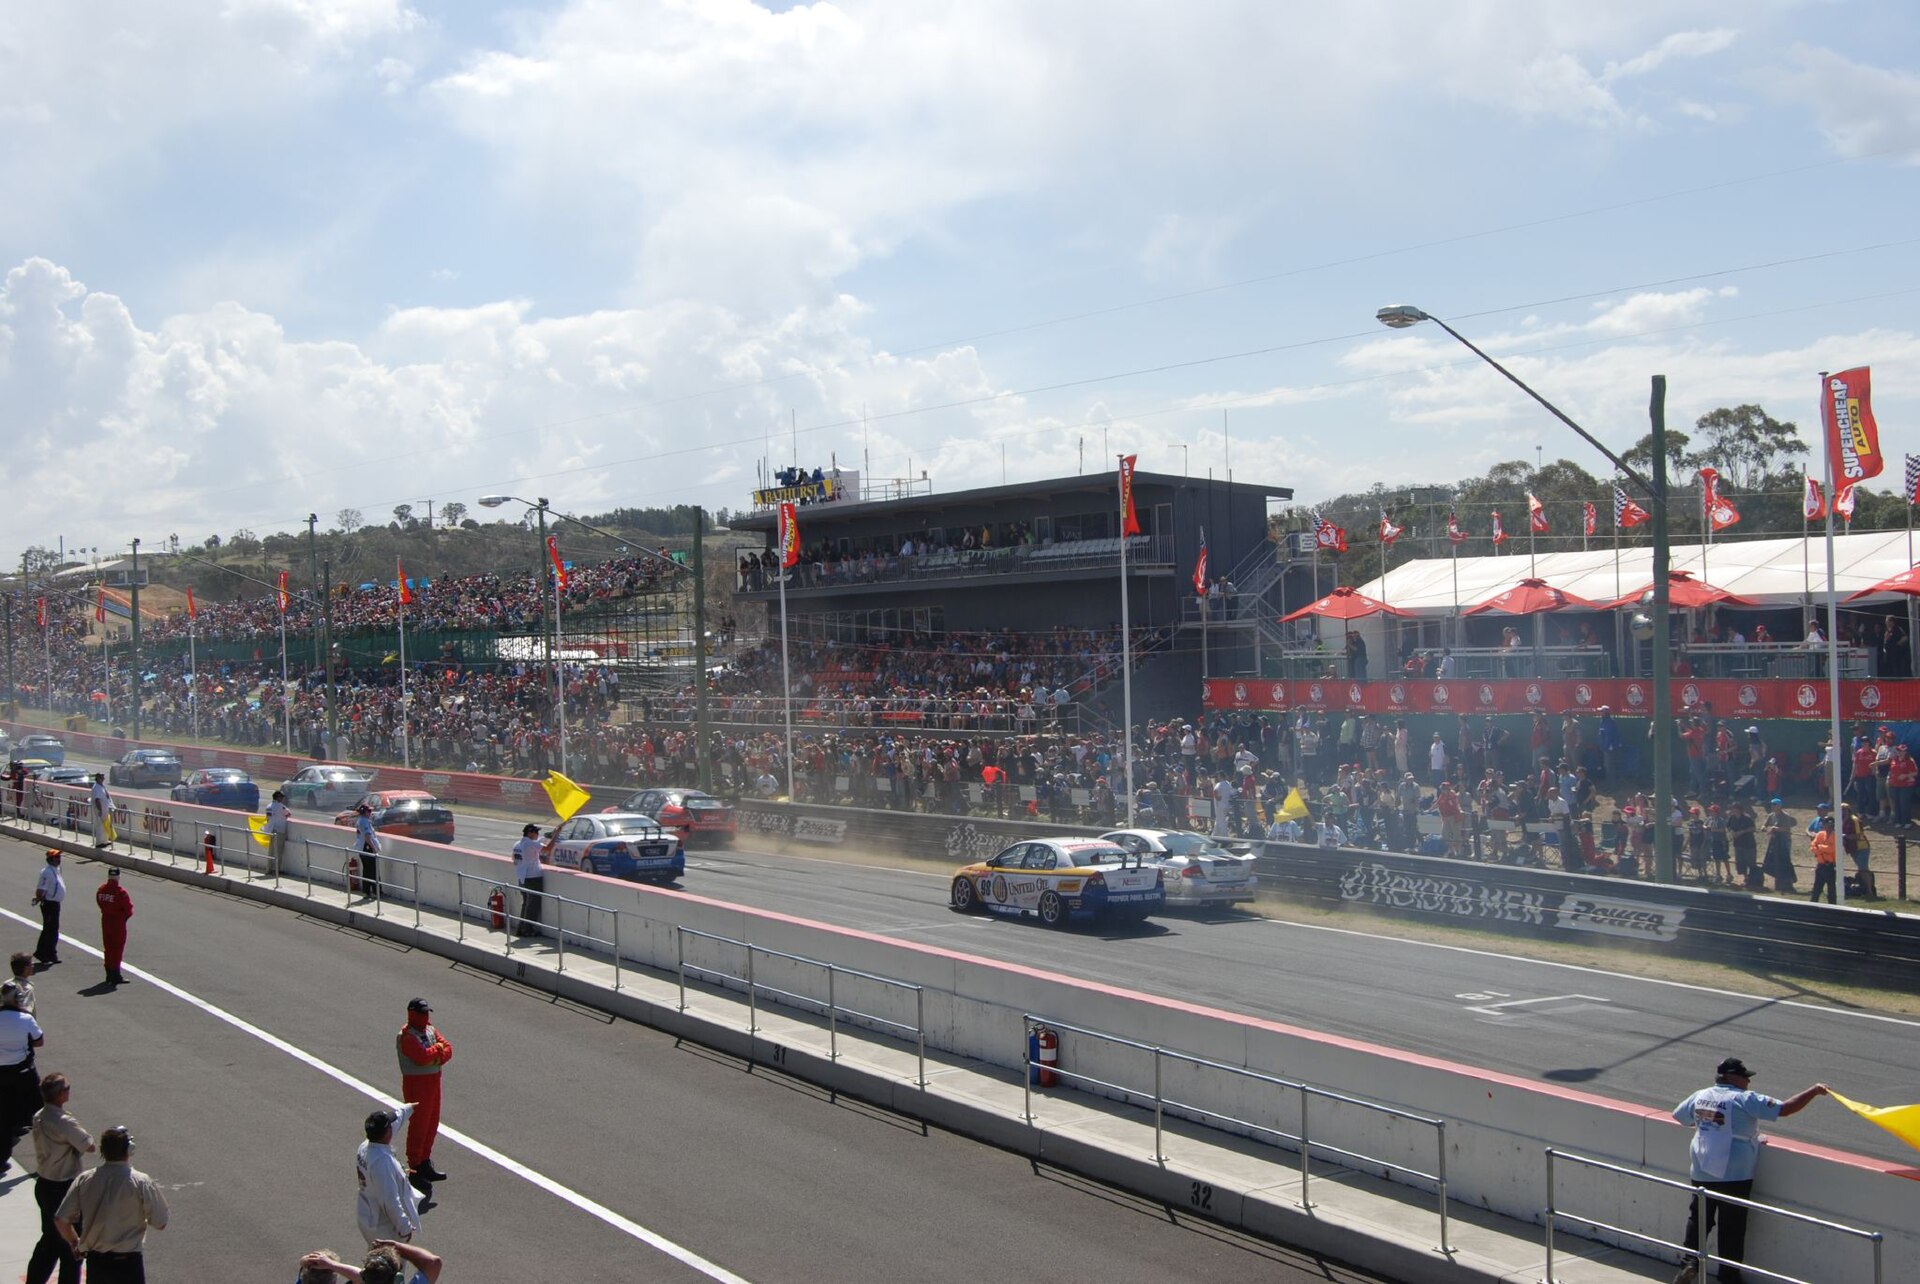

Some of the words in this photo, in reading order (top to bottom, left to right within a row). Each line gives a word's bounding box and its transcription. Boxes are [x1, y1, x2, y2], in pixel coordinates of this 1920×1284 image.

[1830, 378, 1864, 479] SUPERCHEAP
[1849, 405, 1867, 448] AUTO
[764, 484, 819, 504] BATHURST
[143, 807, 170, 833] SANYO
[554, 847, 579, 866] GMAC
[98, 893, 116, 903] FIRE
[980, 879, 991, 896] 98
[1008, 881, 1036, 896] UNITED
[1036, 877, 1050, 892] OIL
[1480, 885, 1545, 925] MEN
[1571, 900, 1668, 936] POWER
[773, 1043, 787, 1066] 31
[1696, 1099, 1727, 1110] OFFICIAL
[1191, 1181, 1212, 1209] 32
